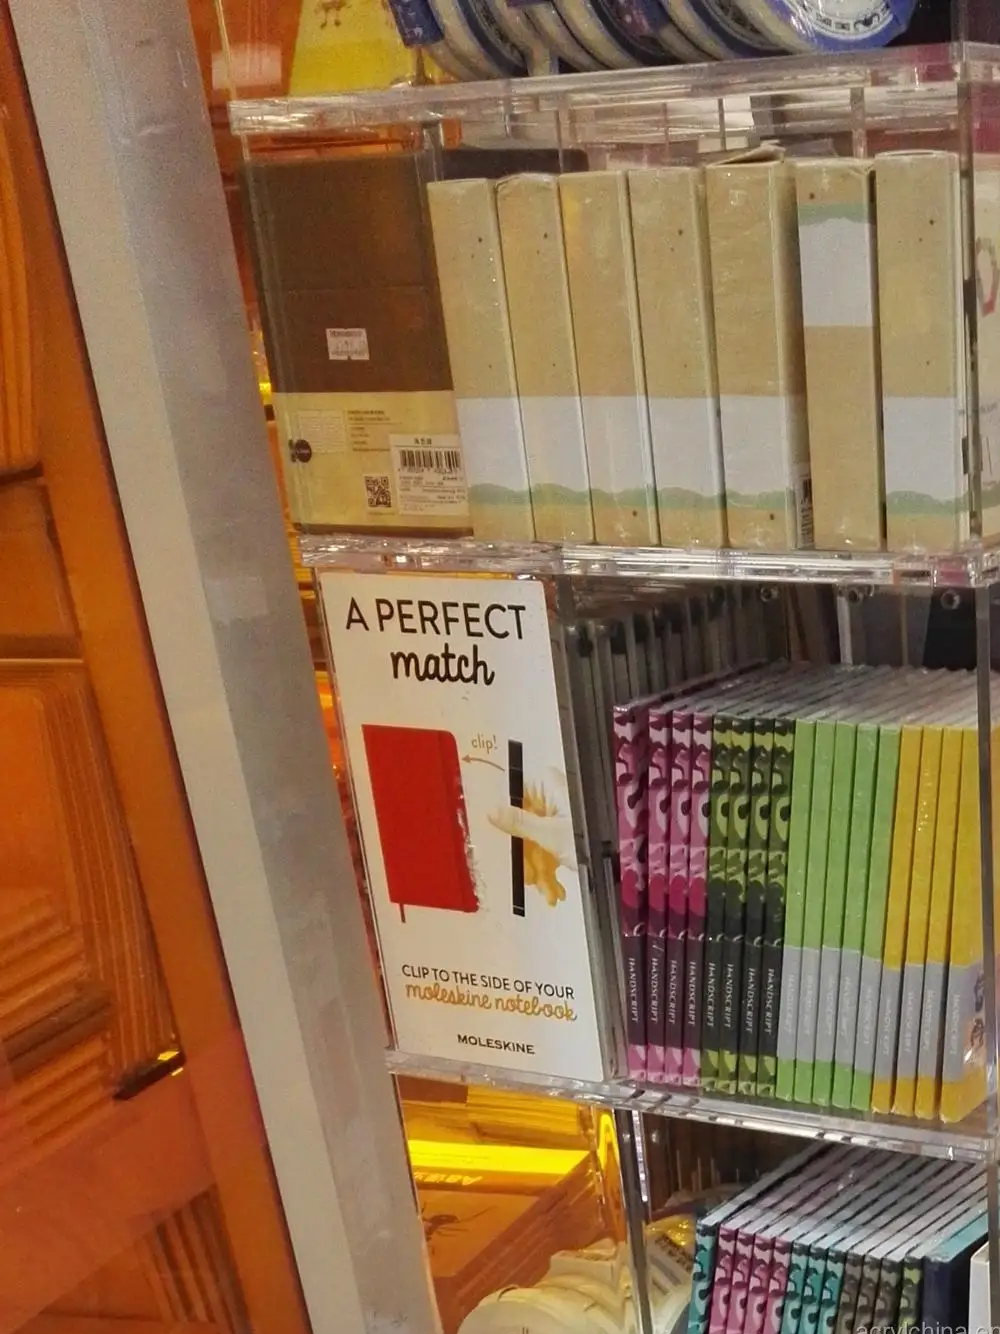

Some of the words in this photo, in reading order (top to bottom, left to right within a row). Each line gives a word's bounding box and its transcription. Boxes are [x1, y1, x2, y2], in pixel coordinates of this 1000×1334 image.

[346, 597, 370, 632] A
[375, 598, 526, 640] PERFECT
[391, 642, 495, 686] match
[471, 732, 499, 755] clip!
[401, 964, 430, 979] CLIP
[432, 968, 450, 983] TO
[452, 971, 478, 987] THE
[481, 975, 511, 991] SIDE
[514, 980, 533, 994] OF
[535, 981, 575, 1000] YOUR
[405, 982, 492, 1010] moleskine
[494, 995, 578, 1021] notebook
[628, 957, 640, 1023] HANDSCRIPT
[650, 957, 660, 1023] HANDSCRIPT
[667, 959, 679, 1025] HANDSCRIPT
[687, 961, 698, 1026] HANDSCRIPT
[706, 962, 717, 1028] HANDSCRIPT
[723, 963, 735, 1029] HANDSCRIPT
[744, 967, 757, 1034] HANDSCRIPT
[763, 968, 776, 1035] HANDSCRIPT
[457, 1034, 536, 1055] MOLESKINE
